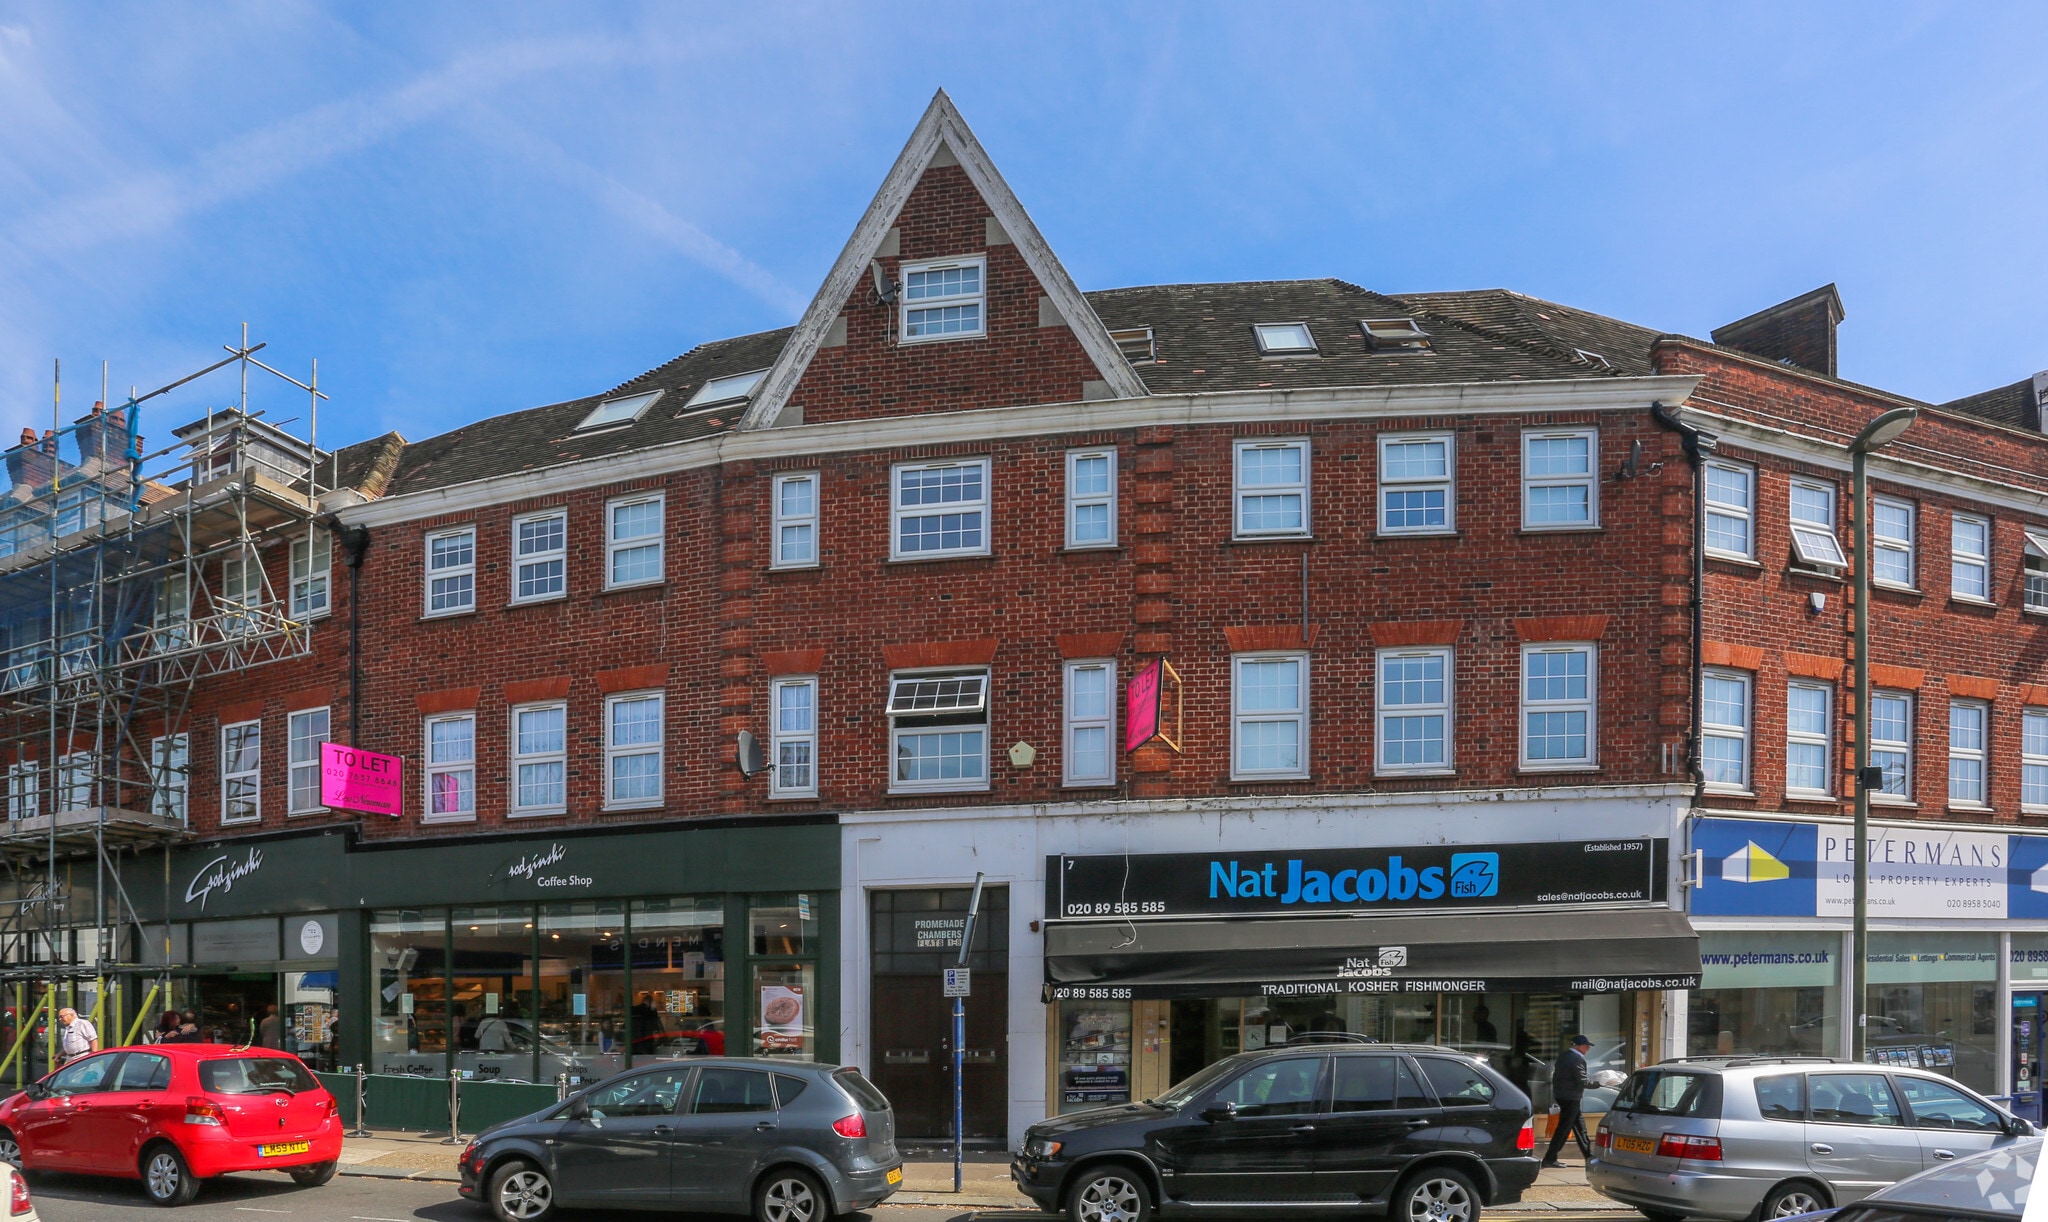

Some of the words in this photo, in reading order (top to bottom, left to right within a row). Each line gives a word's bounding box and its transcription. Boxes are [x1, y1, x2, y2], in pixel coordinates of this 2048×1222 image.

[1131, 681, 1140, 701] TO
[1142, 669, 1155, 693] LET
[333, 749, 356, 767] TO
[361, 754, 391, 774] LET
[326, 768, 344, 778] 020
[1584, 843, 1621, 853] (Established
[1623, 842, 1643, 852] 1957)
[1825, 837, 2000, 867] PETERMANS
[1067, 860, 1075, 870] 7
[537, 876, 567, 887] Coffee
[569, 875, 593, 888] Shop
[1209, 860, 1278, 898] Nat
[1280, 855, 1446, 904] Jacobs
[1836, 874, 1874, 884] LOL
[1880, 875, 1939, 886] PROPERTY
[1945, 877, 1992, 887] EXPERTS
[1454, 880, 1477, 894] Fish
[359, 897, 365, 905] 6
[1537, 890, 1642, 902] sales@natjacobs.co.uk
[1825, 897, 1896, 906] www.petans.co.uk
[1067, 903, 1092, 914] 020
[1095, 903, 1111, 914] 89
[1114, 902, 1138, 913] 585
[1141, 901, 1165, 913] 585
[1946, 899, 1961, 908] 020
[1963, 899, 1981, 908] 8958
[1983, 899, 2000, 909] 5040
[915, 919, 965, 929] PROMENADE
[917, 930, 962, 940] CHAMBERS
[917, 939, 944, 947] FLATS
[1701, 949, 1829, 968] www.petermans.co.uk
[1895, 953, 1910, 962] Sales
[1917, 953, 1938, 964] Lettings
[1943, 952, 1977, 961] Commercial
[1978, 953, 1996, 962] Agents
[2027, 950, 2048, 962] 8958
[1346, 957, 1370, 968] Nat
[1336, 965, 1392, 978] Jacobs
[1261, 982, 1342, 995] TRADITIONAL
[1348, 981, 1400, 992] KOSHER
[1405, 980, 1486, 992] FISHMONGER
[1571, 976, 1697, 992] mail@natjacobs.co.uk
[1073, 988, 1086, 998] 89
[1089, 988, 1109, 999] 585
[1111, 988, 1132, 999] 585
[383, 1064, 405, 1073] Fresh
[406, 1064, 434, 1074] Coffee
[478, 1063, 501, 1076] Soup
[566, 1066, 588, 1075] Chips
[264, 1143, 287, 1155] LM59
[289, 1141, 306, 1152] NTC
